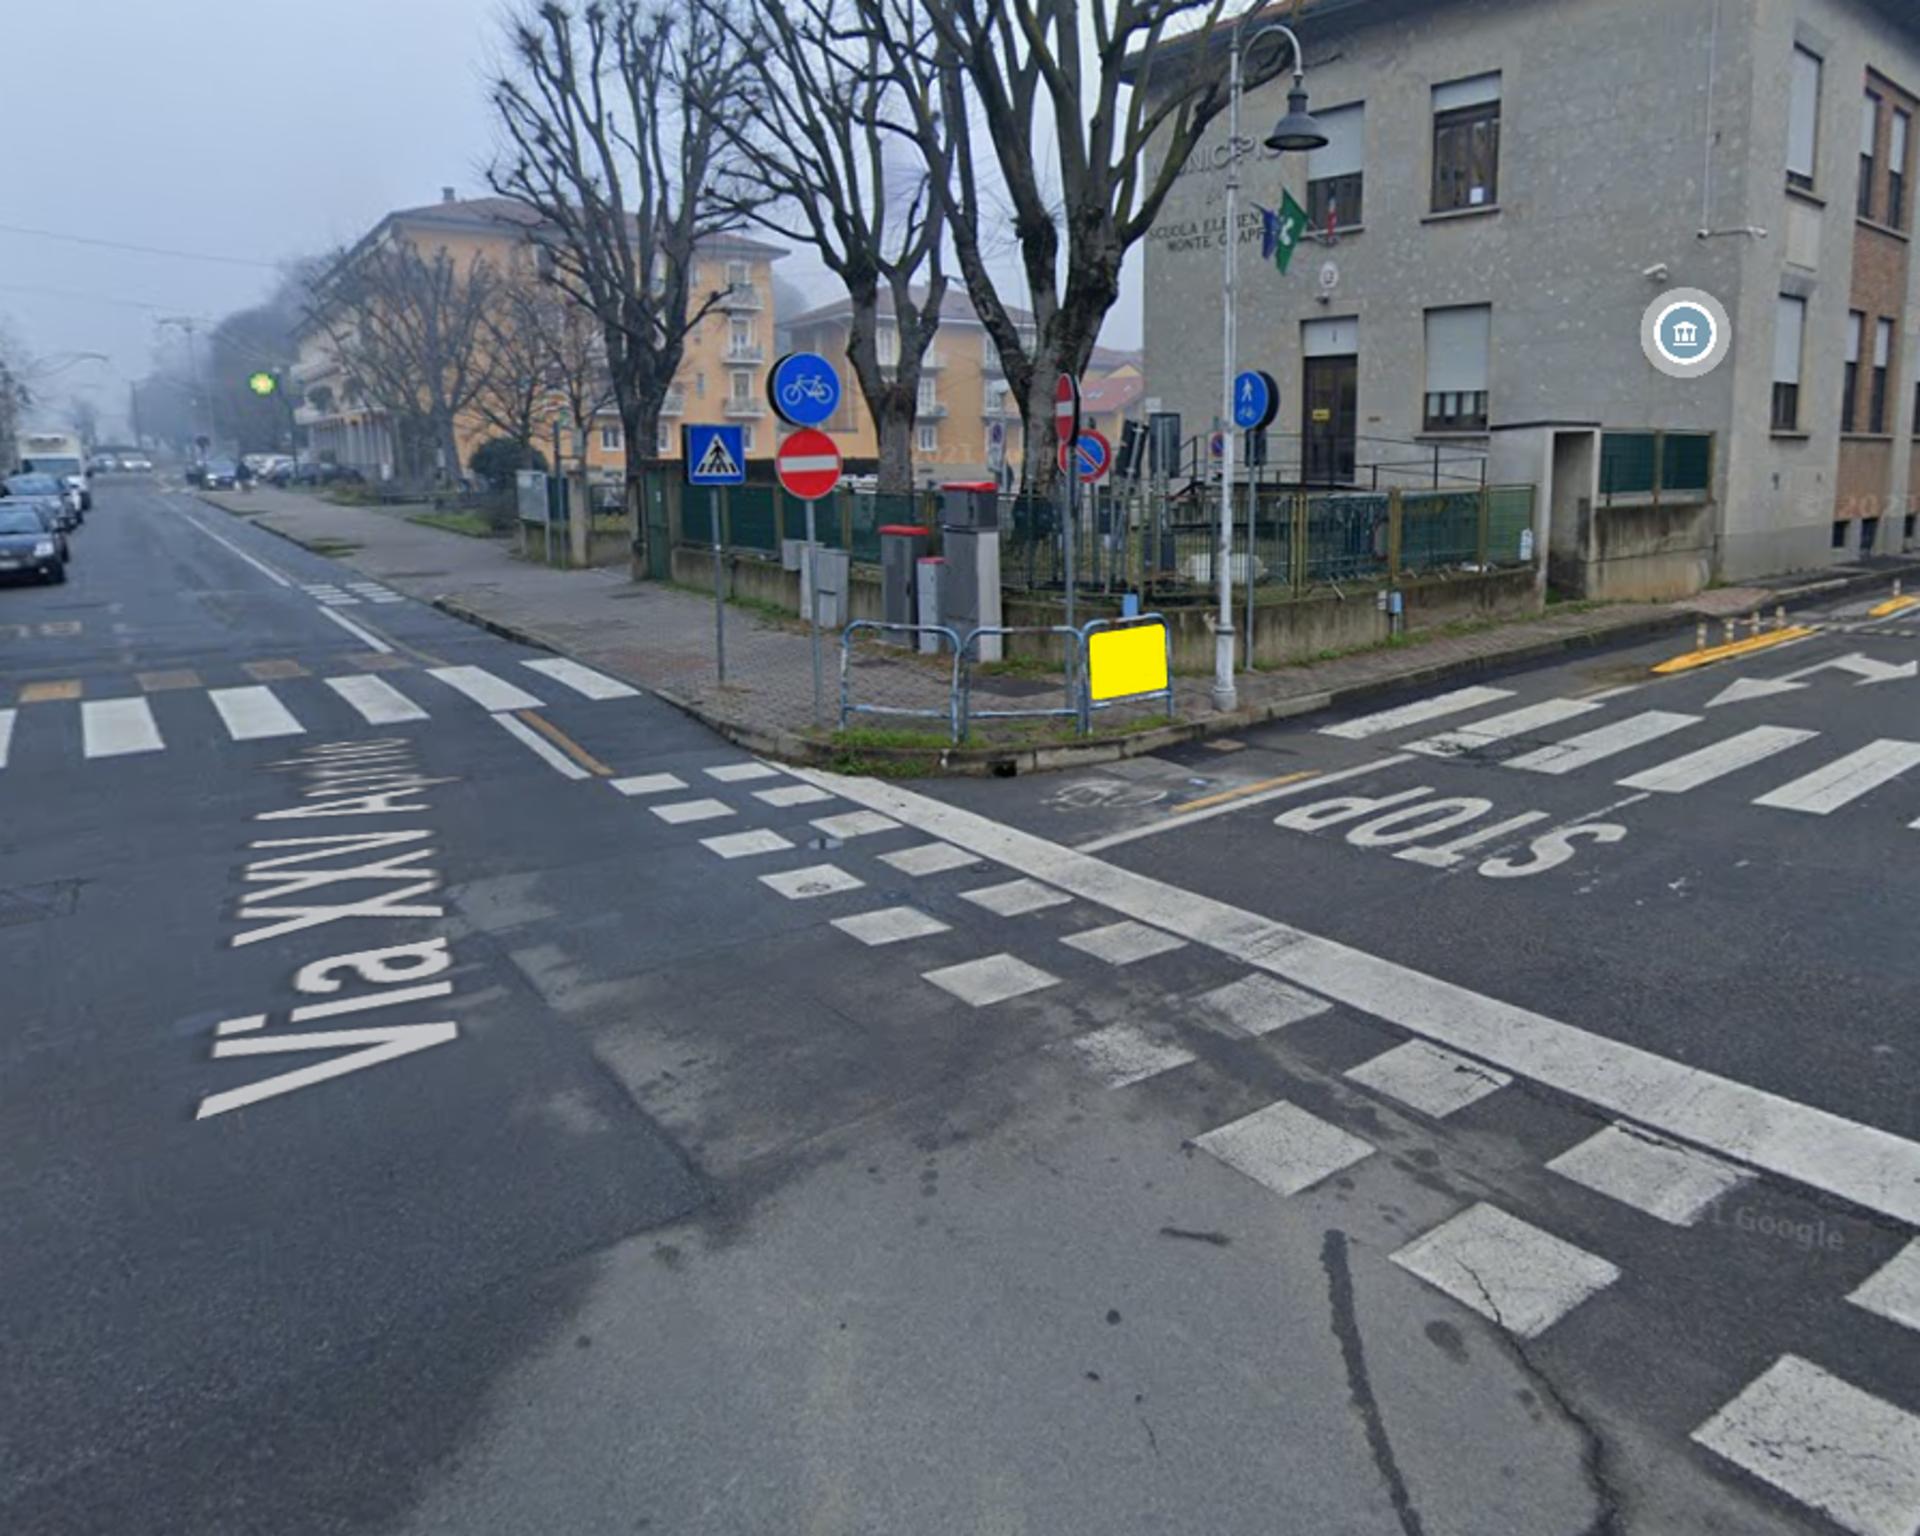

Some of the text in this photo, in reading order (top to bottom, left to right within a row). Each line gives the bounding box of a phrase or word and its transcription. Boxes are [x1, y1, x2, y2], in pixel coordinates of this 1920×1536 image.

[1149, 222, 1198, 241] SCUOLA
[1167, 235, 1212, 252] MONTE
[1273, 785, 1628, 878] STOP
